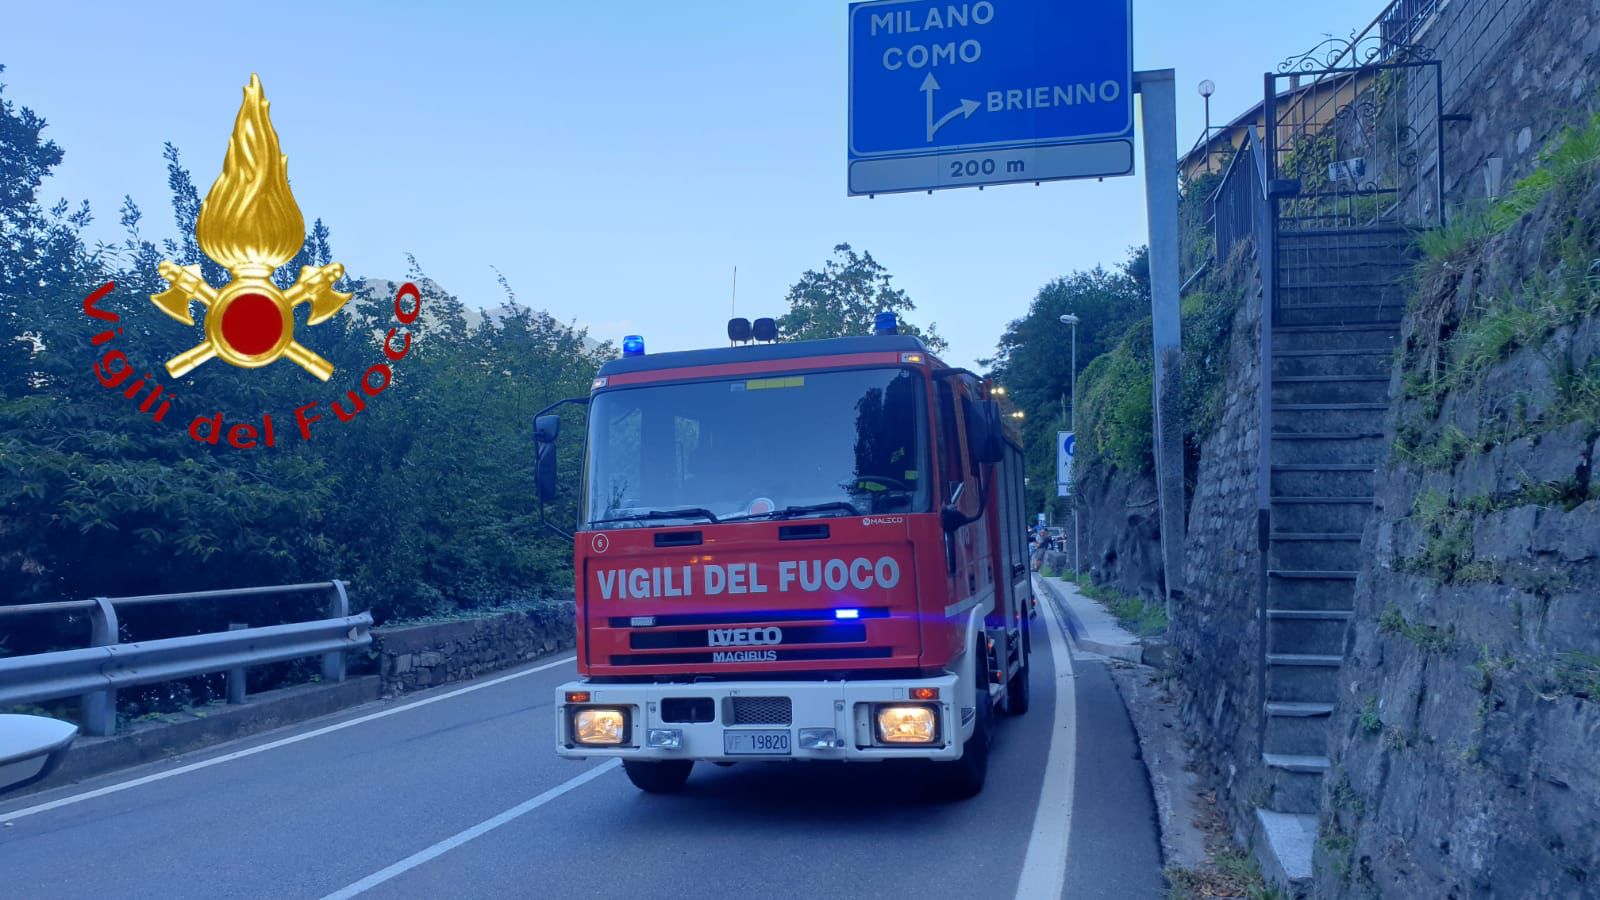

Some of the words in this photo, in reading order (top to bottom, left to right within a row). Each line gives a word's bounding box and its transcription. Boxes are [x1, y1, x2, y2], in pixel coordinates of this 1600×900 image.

[871, 1, 994, 36] MILANO
[882, 39, 982, 70] COMO
[987, 80, 1120, 112] BRIENNO
[951, 158, 995, 177] 200
[1006, 159, 1025, 173] m
[597, 565, 692, 600] VIGILI
[704, 563, 768, 595] DEL
[779, 556, 900, 592] FUOCO
[707, 626, 783, 647] IVECO
[752, 735, 788, 750] 19820
